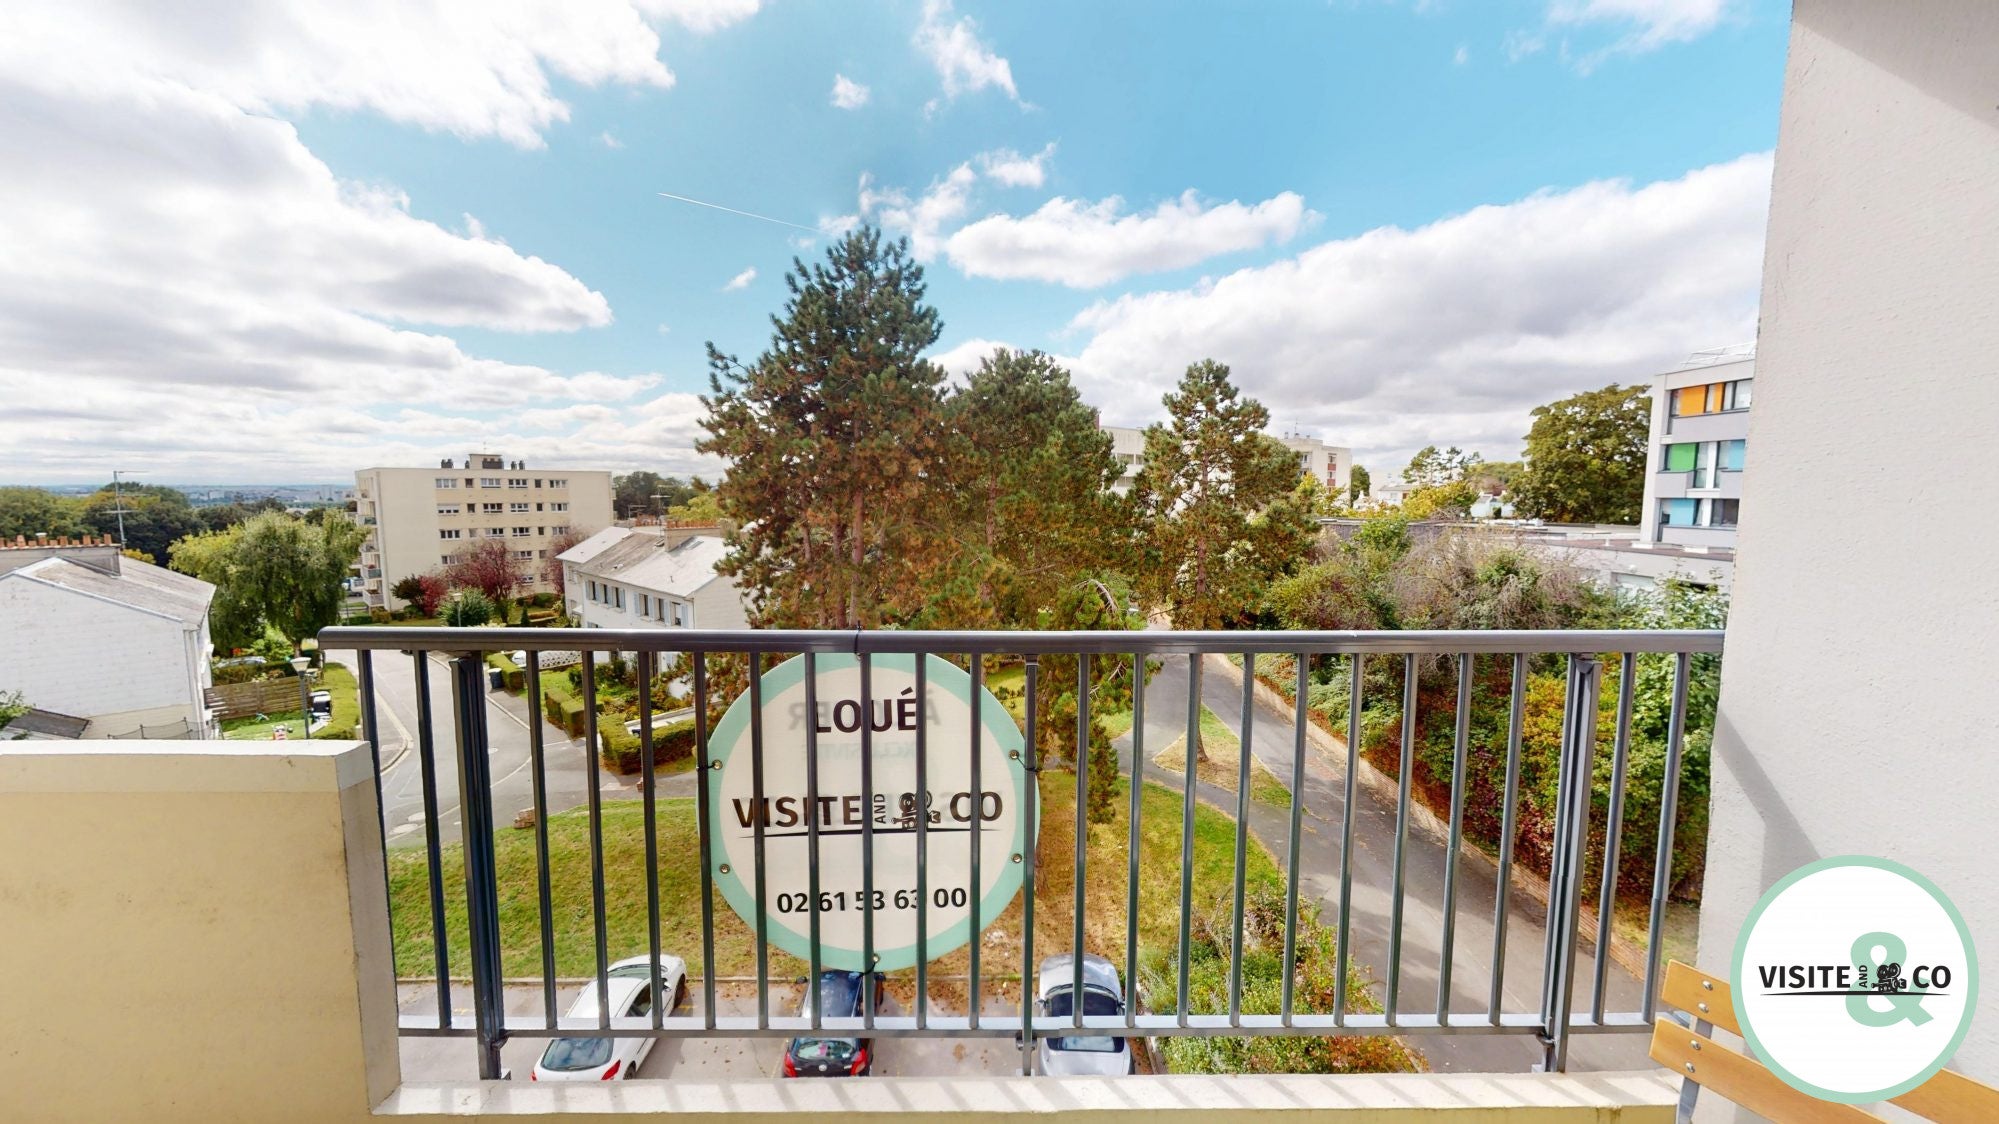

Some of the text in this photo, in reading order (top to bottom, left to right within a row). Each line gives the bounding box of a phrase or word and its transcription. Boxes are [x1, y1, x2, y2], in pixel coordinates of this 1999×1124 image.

[814, 686, 918, 733] LOUÉ
[732, 791, 1003, 828] VISITE AND CO
[776, 893, 809, 913] 02
[819, 891, 846, 912] 61
[933, 887, 967, 908] 00
